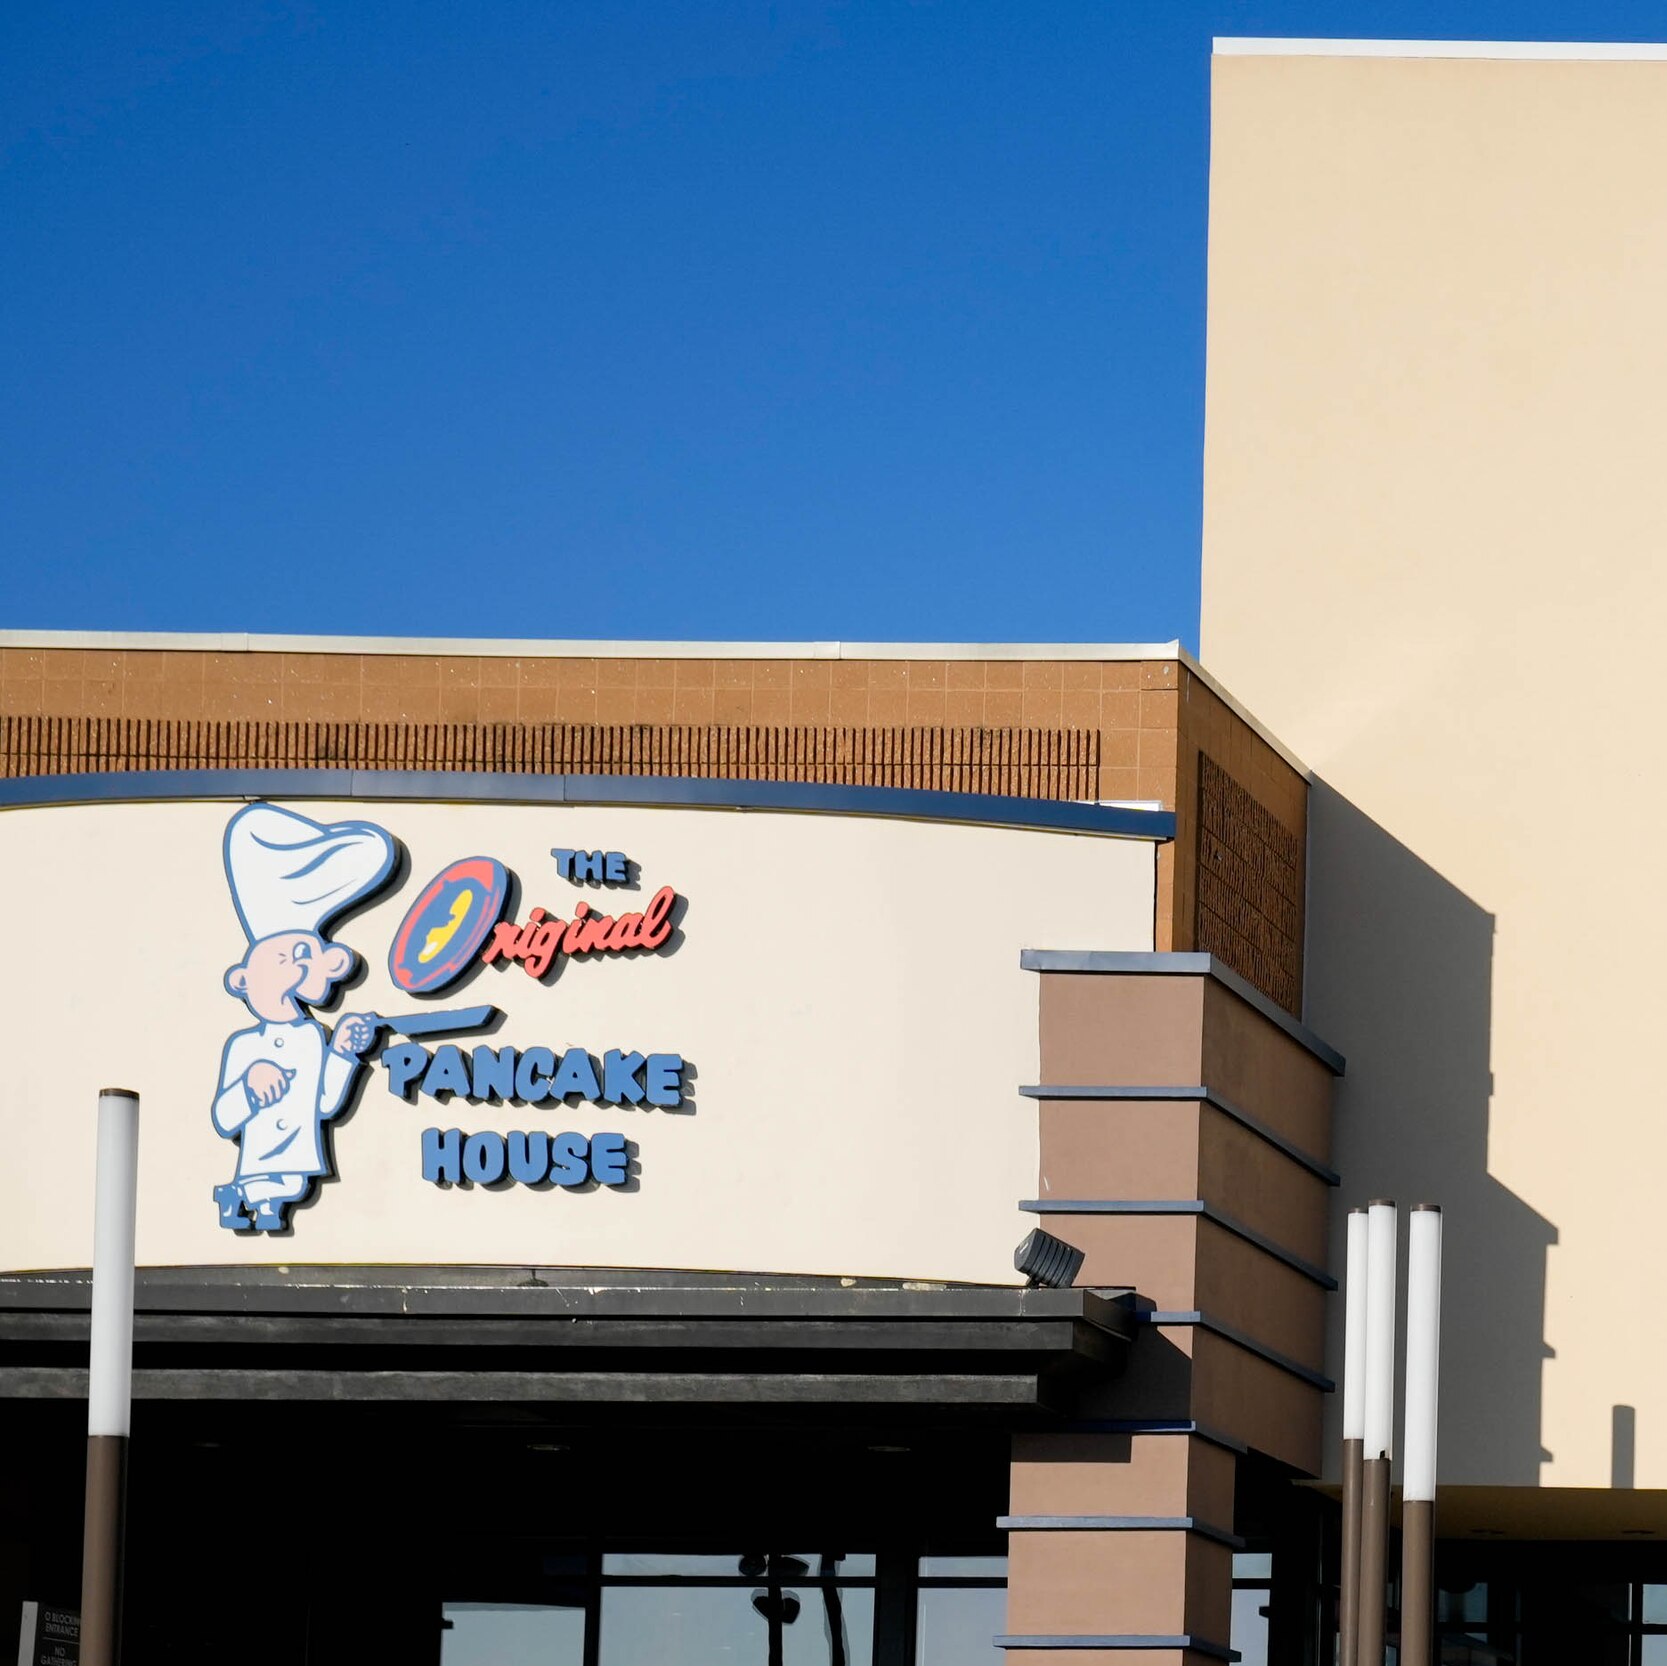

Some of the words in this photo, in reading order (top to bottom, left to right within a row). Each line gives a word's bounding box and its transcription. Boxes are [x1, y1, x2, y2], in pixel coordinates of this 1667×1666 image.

[551, 848, 628, 882] THE
[381, 1042, 684, 1107] PANCAKE
[420, 1127, 631, 1186] HOUSE
[45, 1623, 78, 1637] ENTRANCE
[54, 1646, 66, 1657] NO
